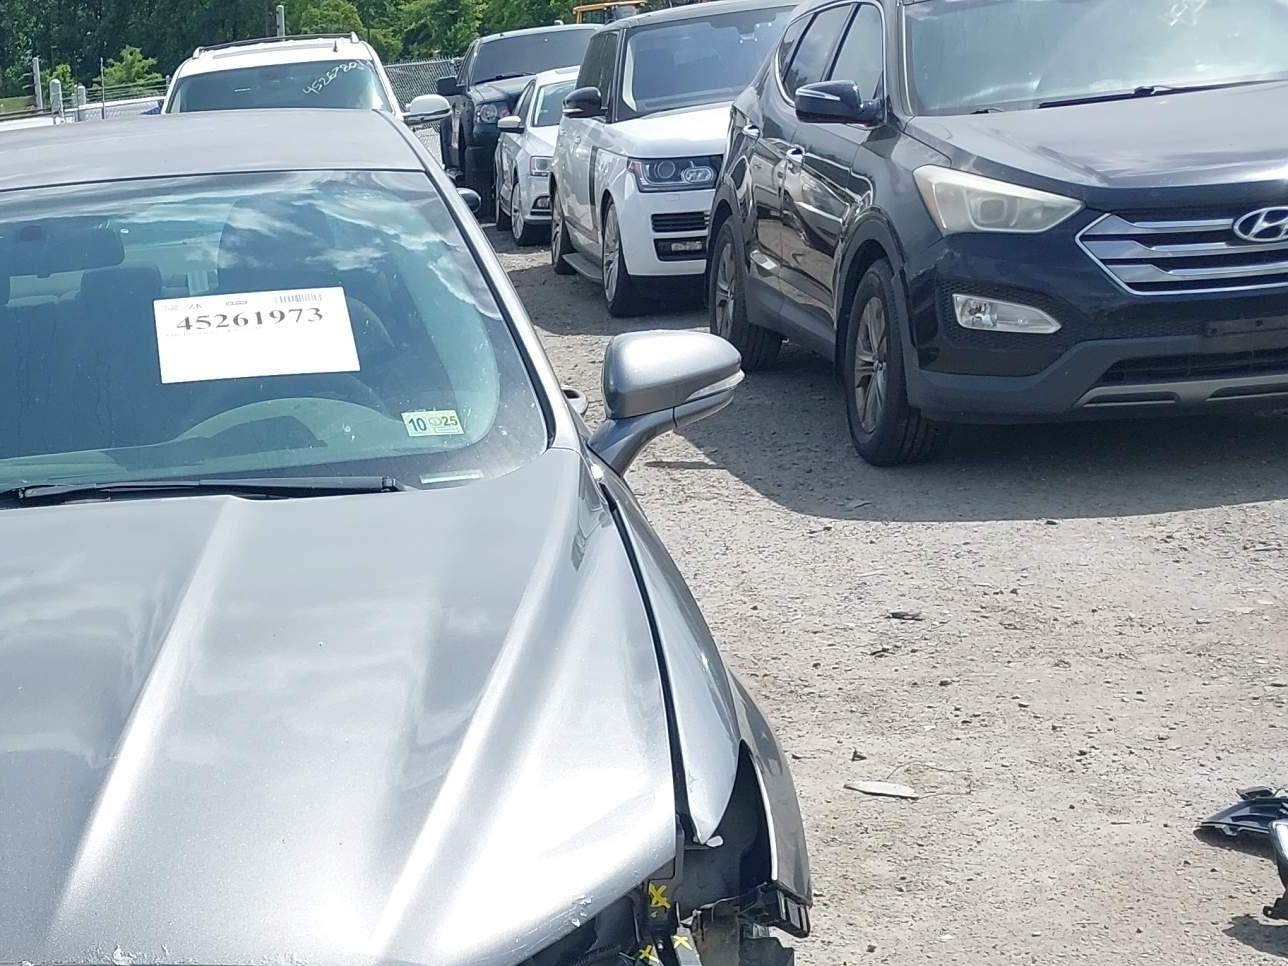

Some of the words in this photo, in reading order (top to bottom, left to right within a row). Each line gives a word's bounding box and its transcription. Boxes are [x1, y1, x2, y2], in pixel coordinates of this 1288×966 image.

[176, 307, 323, 330] 45261973
[408, 417, 427, 431] 10
[441, 415, 458, 426] 25
